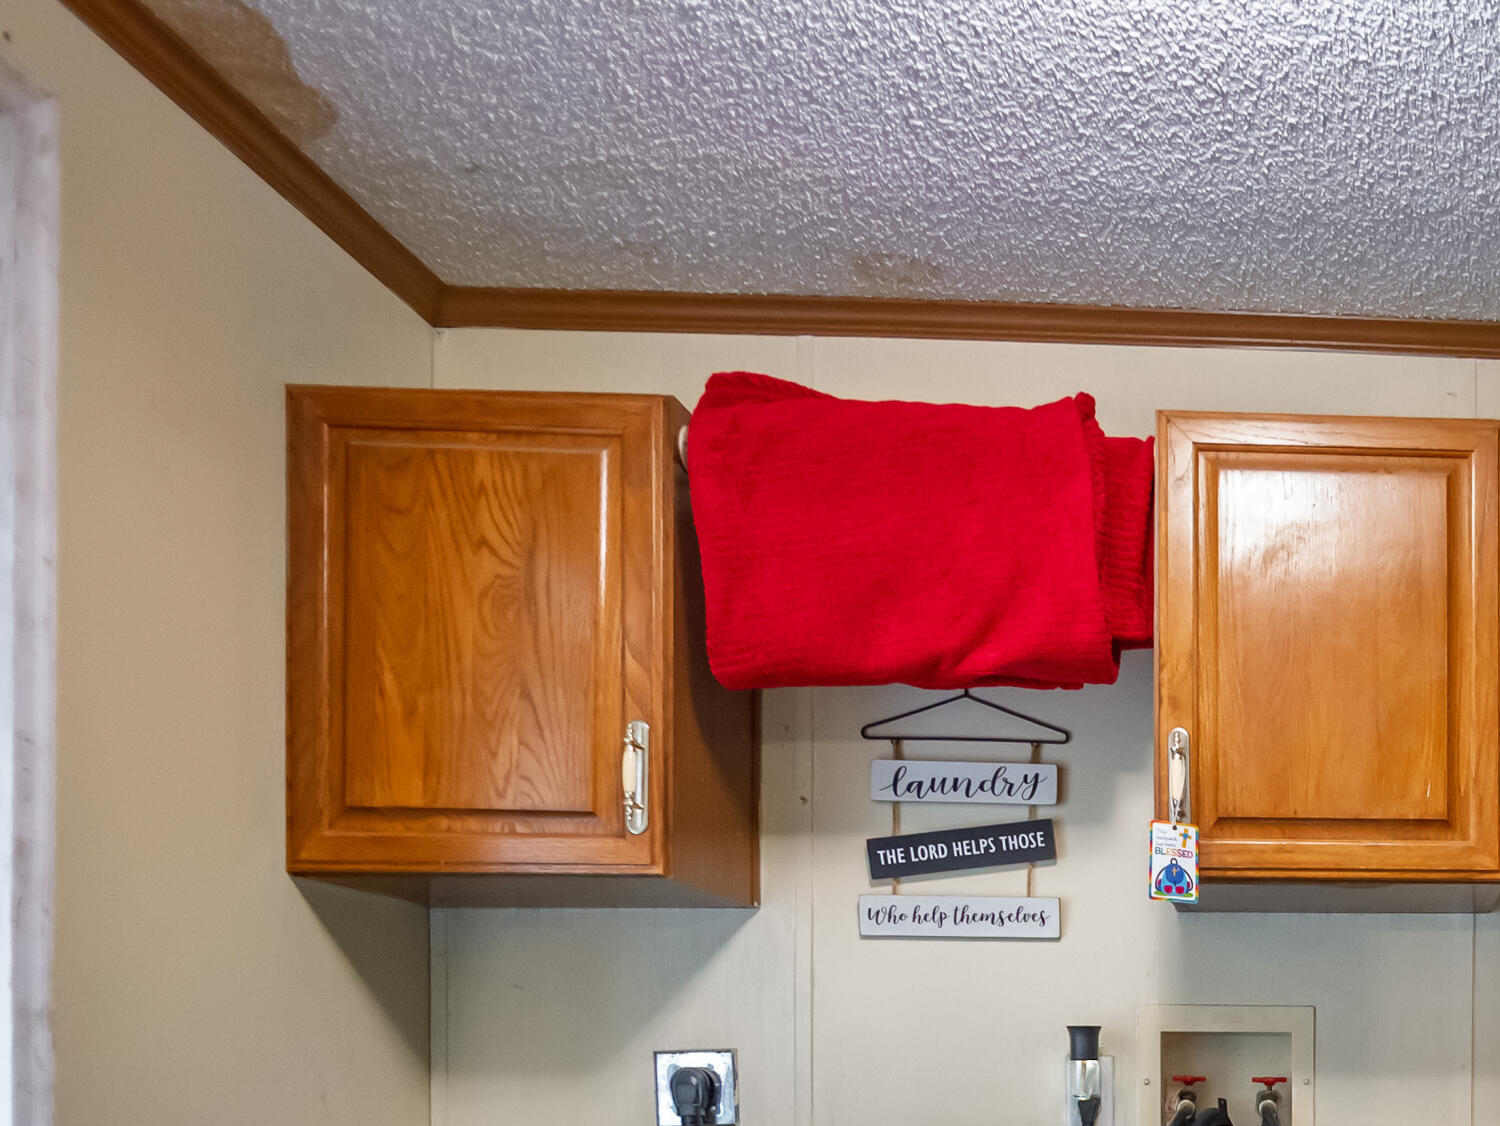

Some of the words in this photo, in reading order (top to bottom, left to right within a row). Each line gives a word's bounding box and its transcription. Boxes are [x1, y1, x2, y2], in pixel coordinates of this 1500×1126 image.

[880, 766, 1048, 800] laundry
[877, 848, 906, 865] THE
[910, 844, 948, 862] LORD
[952, 837, 996, 858] HELPS
[999, 832, 1046, 851] THOSE
[1155, 846, 1193, 859] BLESSED
[867, 905, 909, 925] Who
[912, 905, 950, 928] help
[953, 905, 1050, 927] themselves
